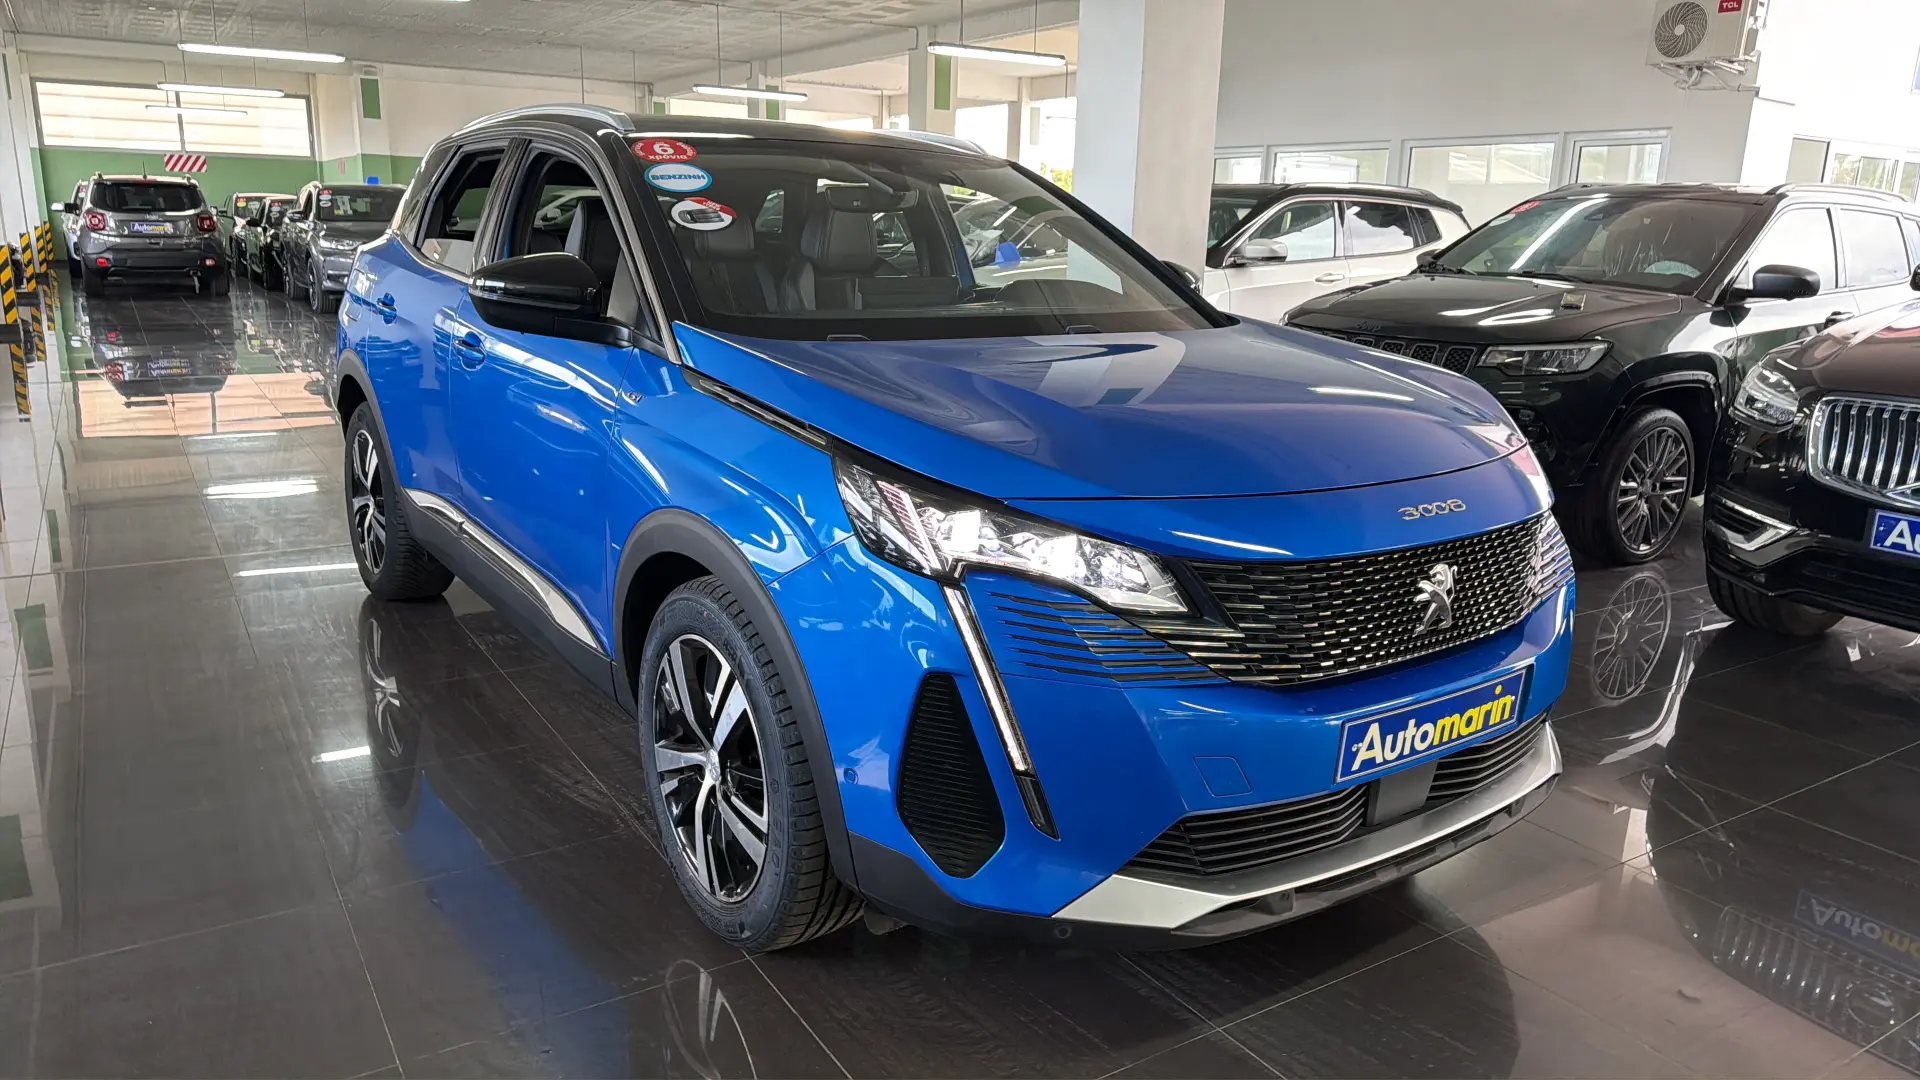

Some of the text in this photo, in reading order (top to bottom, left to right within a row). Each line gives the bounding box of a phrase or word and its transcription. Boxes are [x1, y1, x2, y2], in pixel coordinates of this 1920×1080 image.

[1722, 1, 1739, 9] TCL
[653, 143, 674, 155] 6
[1397, 499, 1467, 520] 3008
[1351, 684, 1513, 772] Automarin
